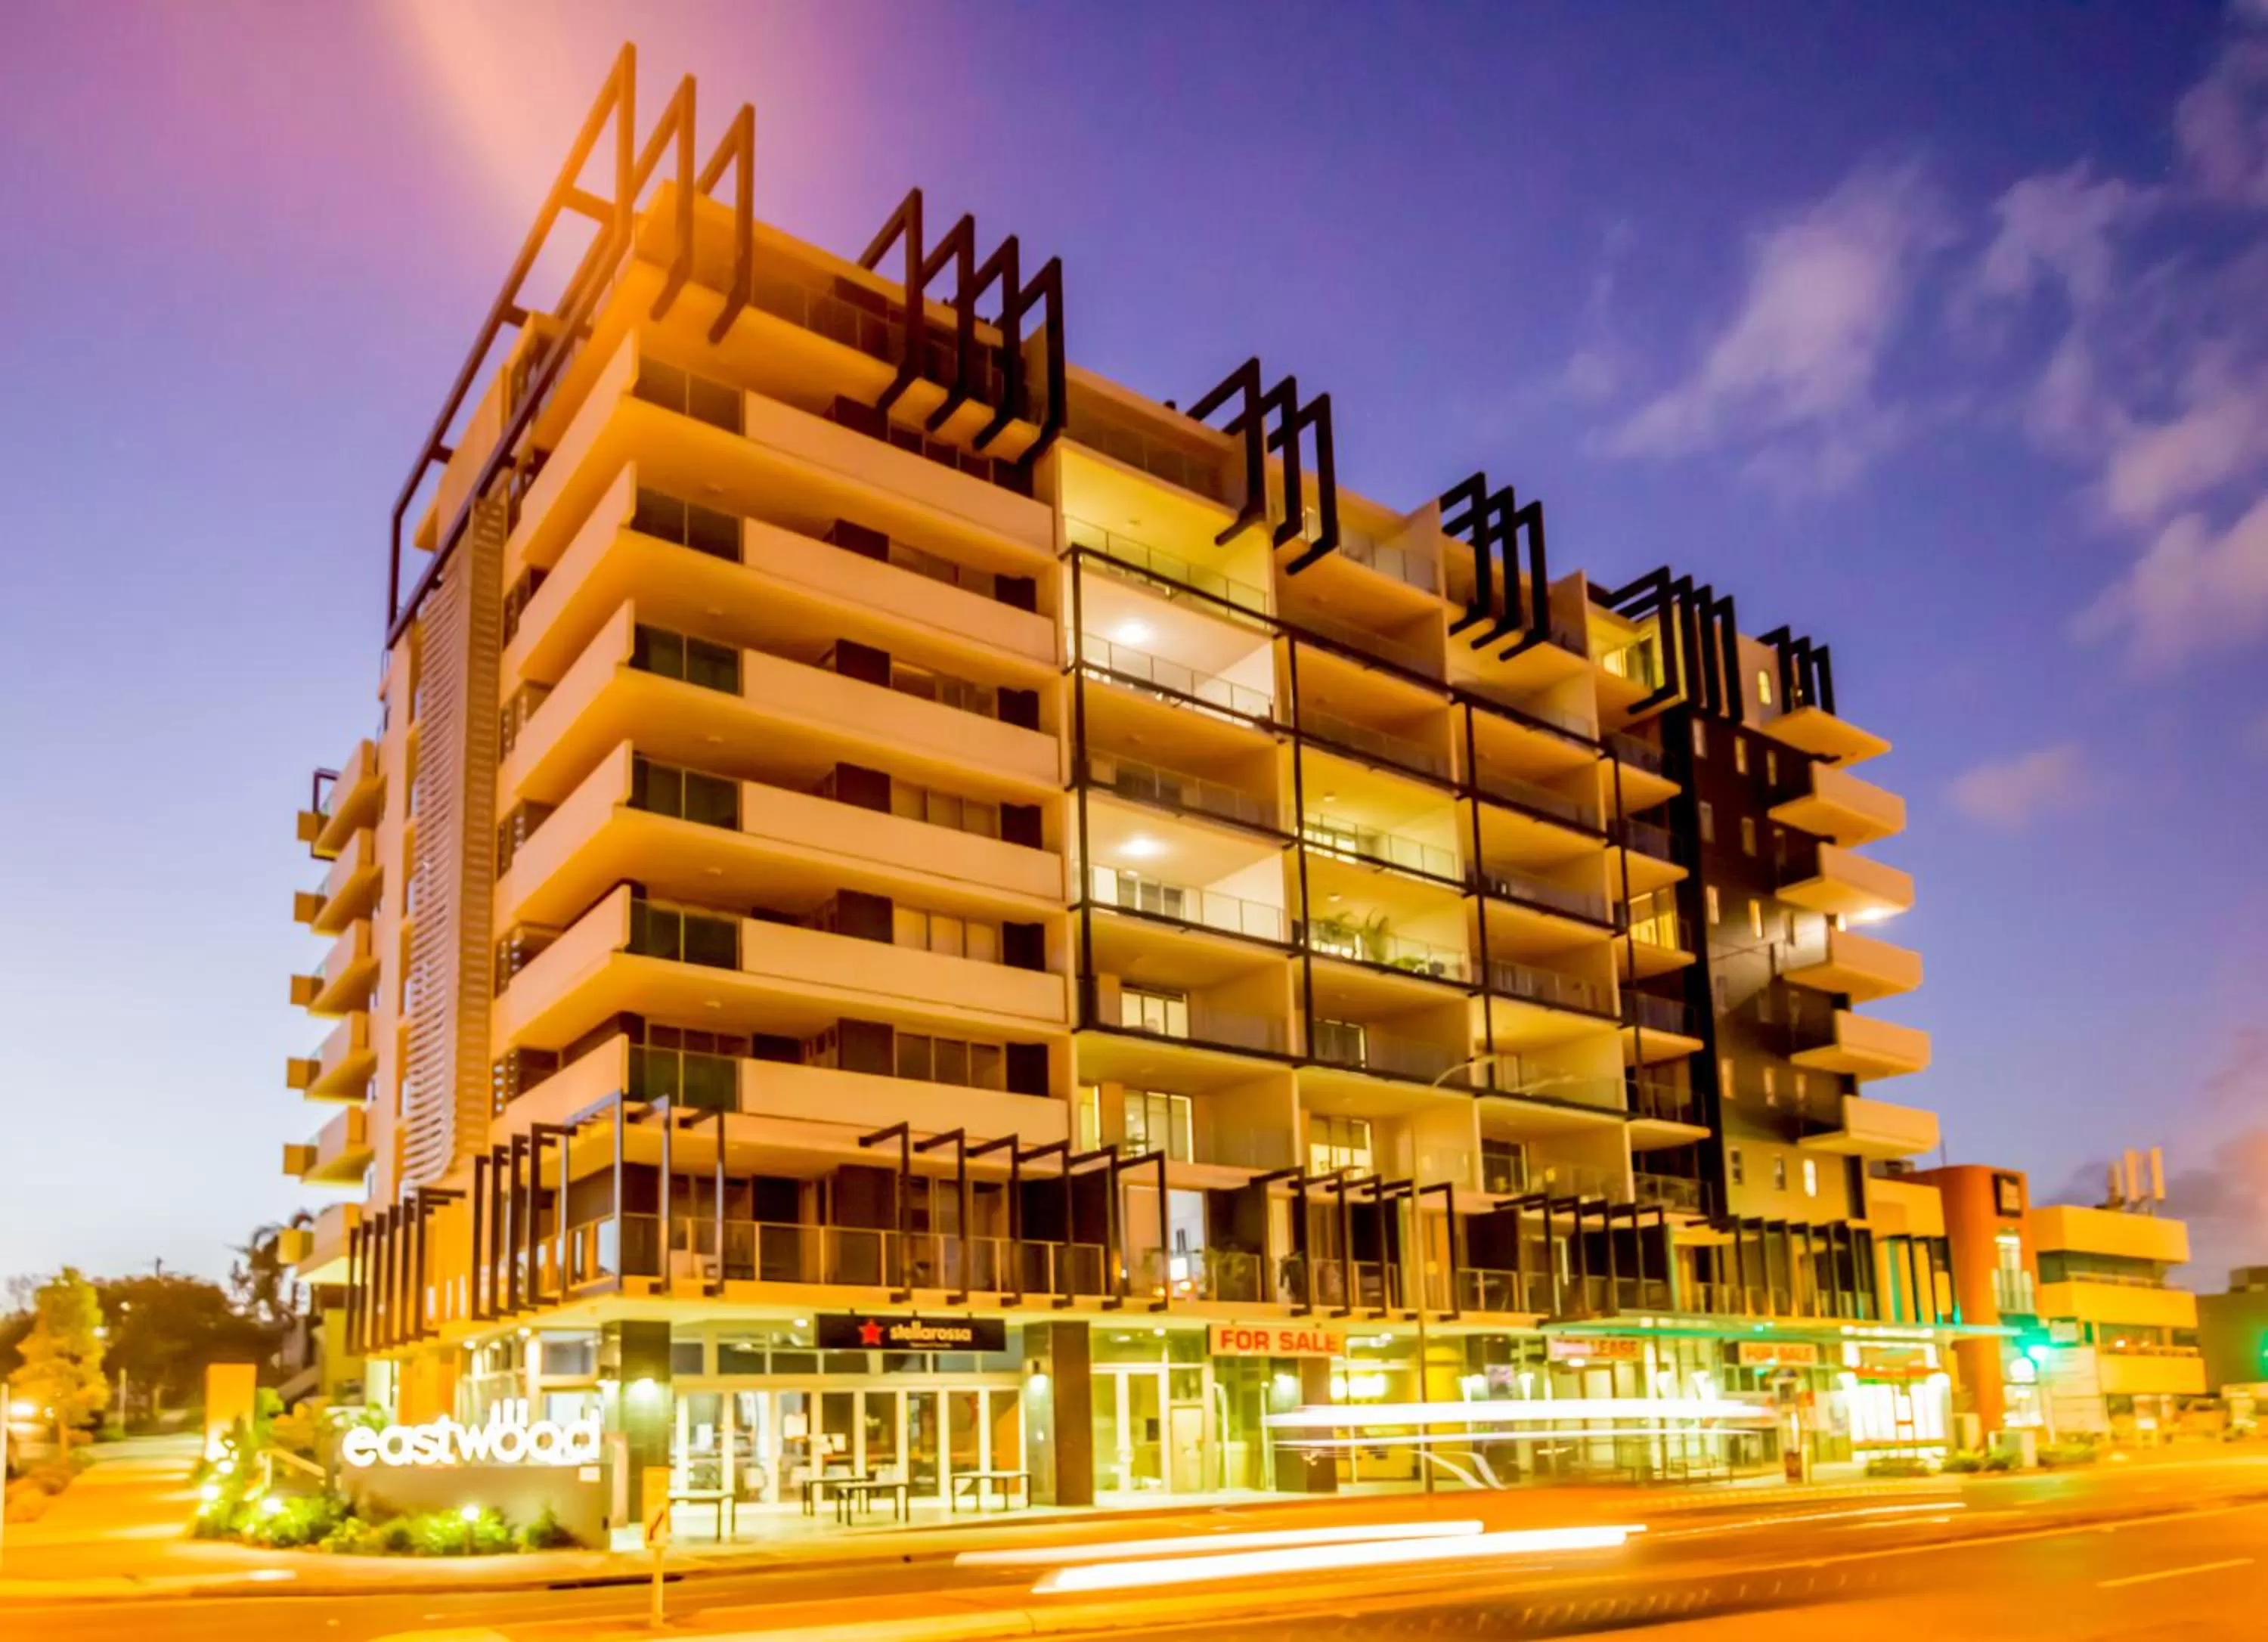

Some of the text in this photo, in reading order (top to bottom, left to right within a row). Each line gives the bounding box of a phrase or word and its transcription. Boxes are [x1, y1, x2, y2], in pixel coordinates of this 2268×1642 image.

[890, 1321, 972, 1342] stellarossa
[1220, 1330, 1339, 1352] FOR SALE
[1590, 1339, 1638, 1357] LEASE
[342, 1398, 600, 1466] eastwood
